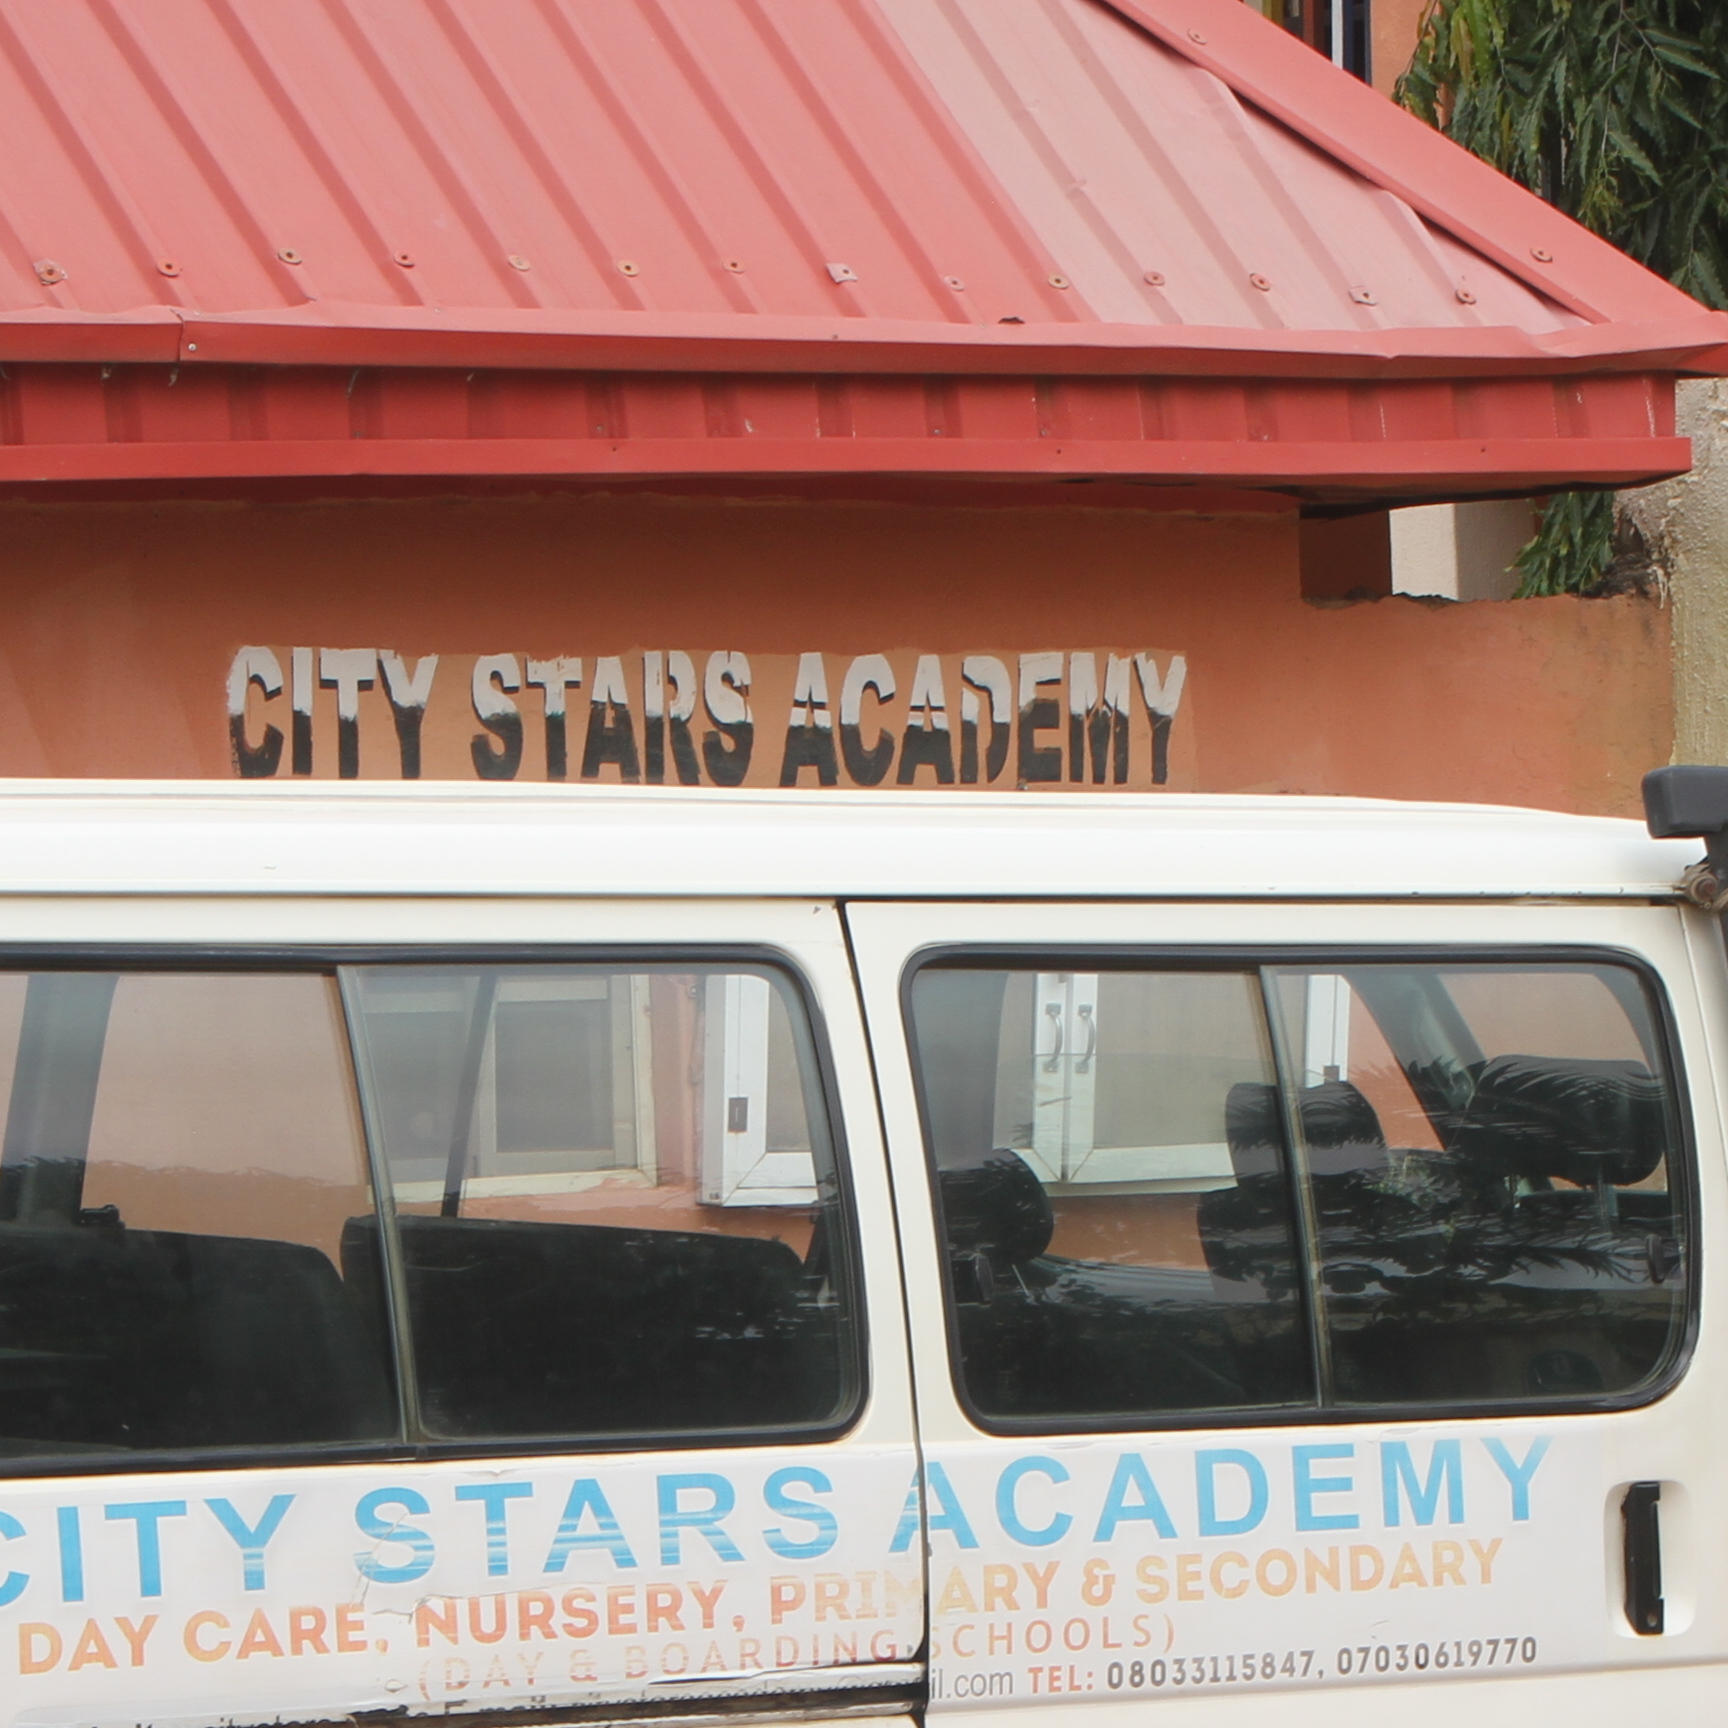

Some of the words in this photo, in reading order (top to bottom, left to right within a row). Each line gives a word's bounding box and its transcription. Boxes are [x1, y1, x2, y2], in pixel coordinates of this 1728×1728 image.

[227, 647, 439, 779] CITY
[471, 650, 753, 788] STARS
[778, 650, 1187, 788] ACADEMY
[353, 1466, 838, 1584] STARS
[887, 1435, 1556, 1553] ACADEMY
[17, 1613, 159, 1676] DAY
[182, 1602, 390, 1663] CARE,
[415, 1578, 747, 1646] NURSERY,
[770, 1559, 1062, 1627] PRIMARY
[1080, 1557, 1115, 1607] &
[1134, 1536, 1505, 1605] SECONDARY
[624, 1629, 899, 1680] BOARDING
[1028, 1664, 1094, 1695] TEL:
[1106, 1649, 1326, 1690] 08033115847,
[1336, 1636, 1539, 1676] 07030619770
